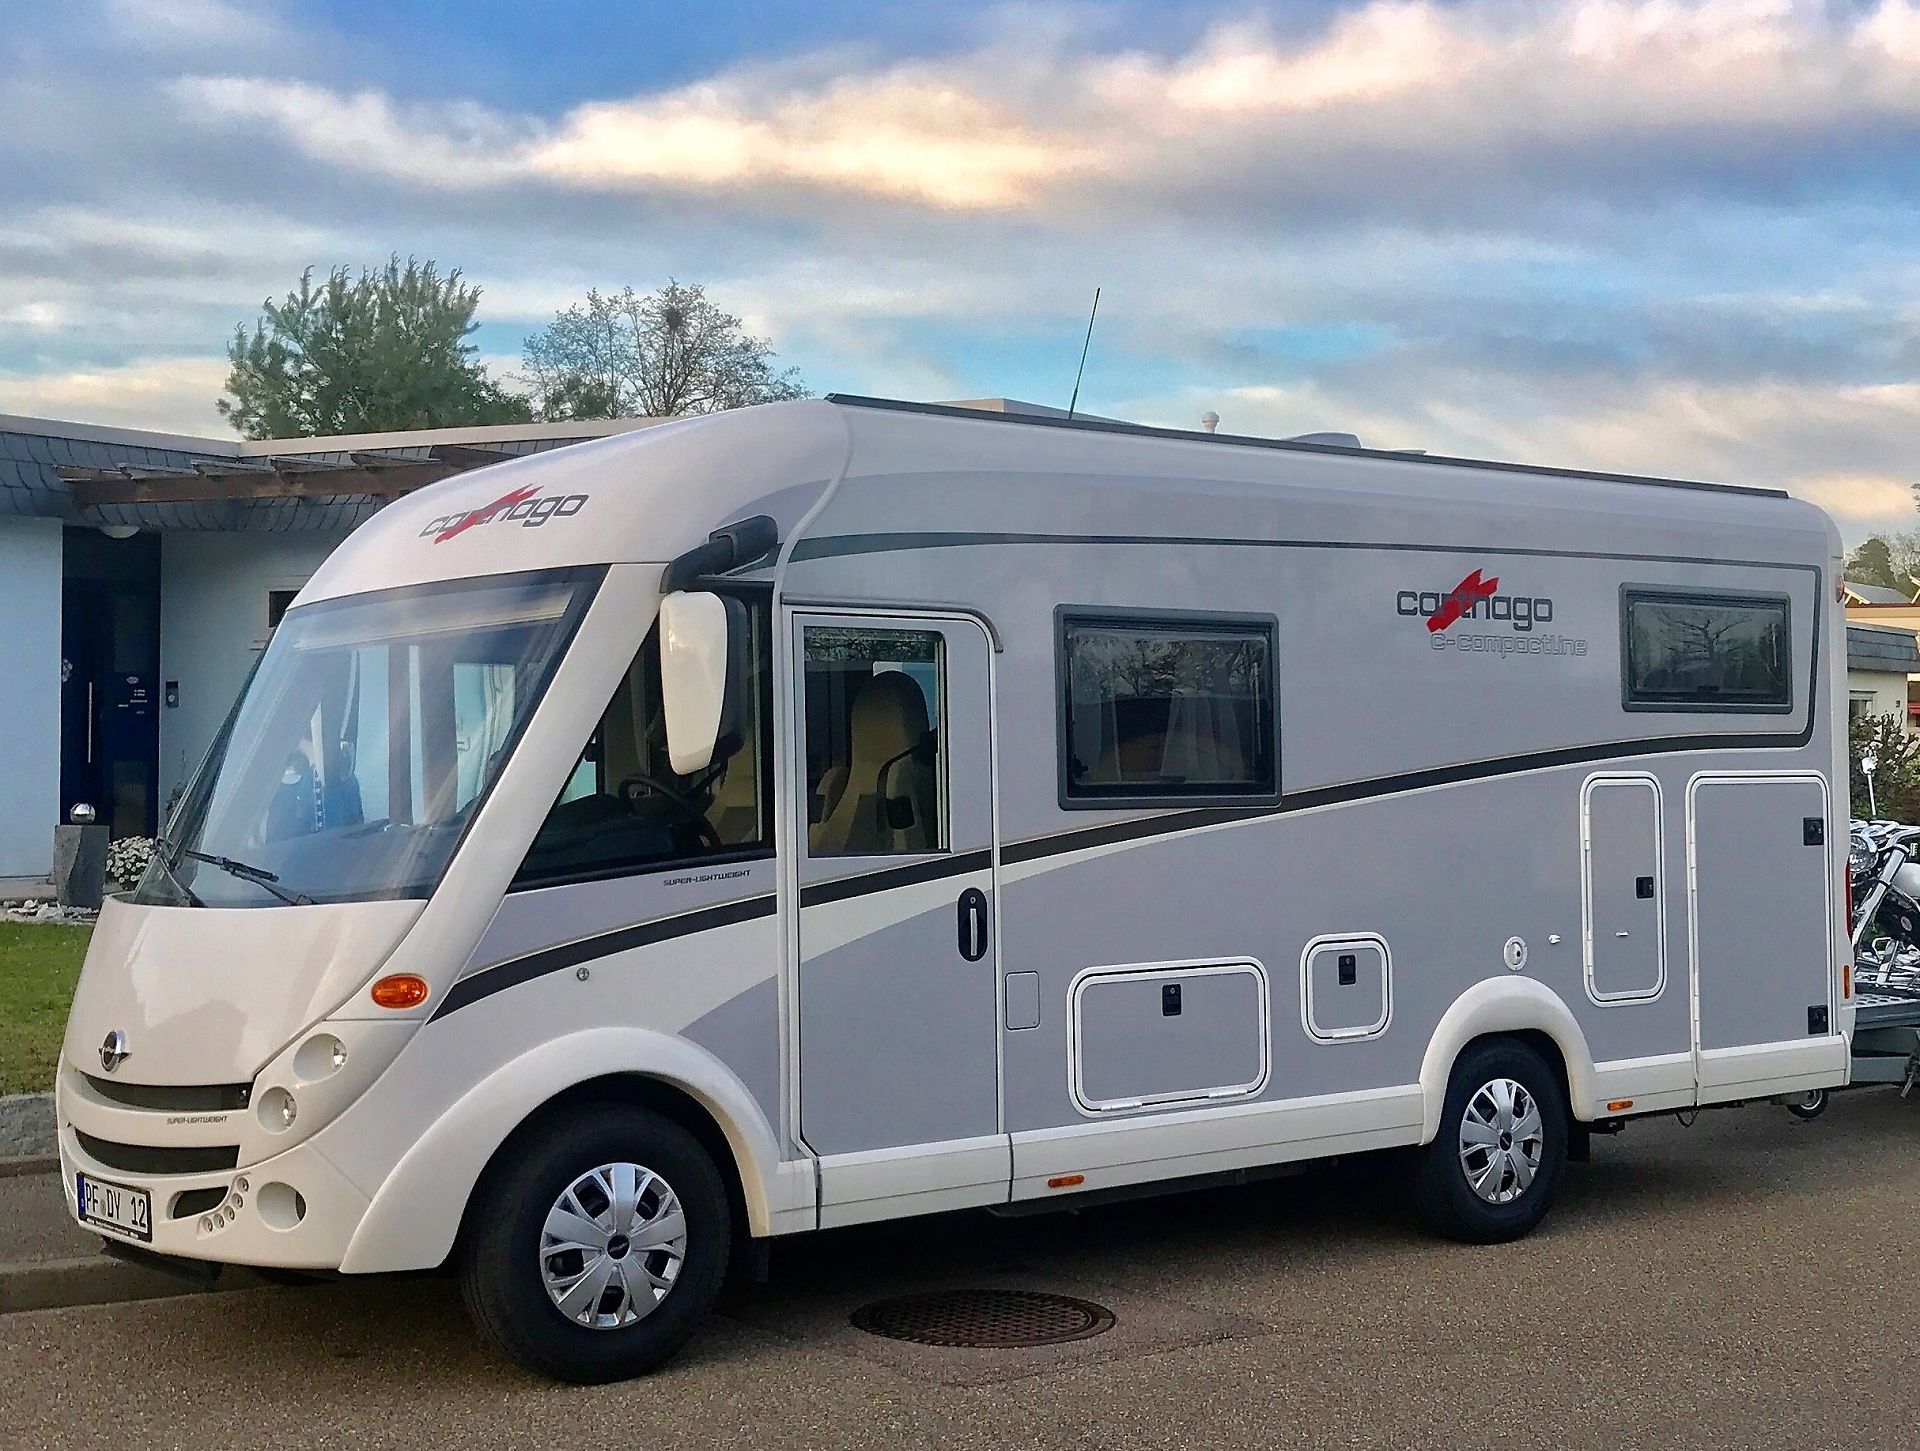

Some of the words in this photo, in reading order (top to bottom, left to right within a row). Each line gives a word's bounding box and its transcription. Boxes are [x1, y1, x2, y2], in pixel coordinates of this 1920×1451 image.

[418, 493, 590, 538] cahago
[663, 868, 752, 887] SUPER-LIGHTWEIGHT
[166, 1115, 228, 1125] SUPER-LIGHTWEIGHT
[85, 1181, 99, 1213] PF
[106, 1188, 121, 1221] DY
[130, 1195, 147, 1229] 12
